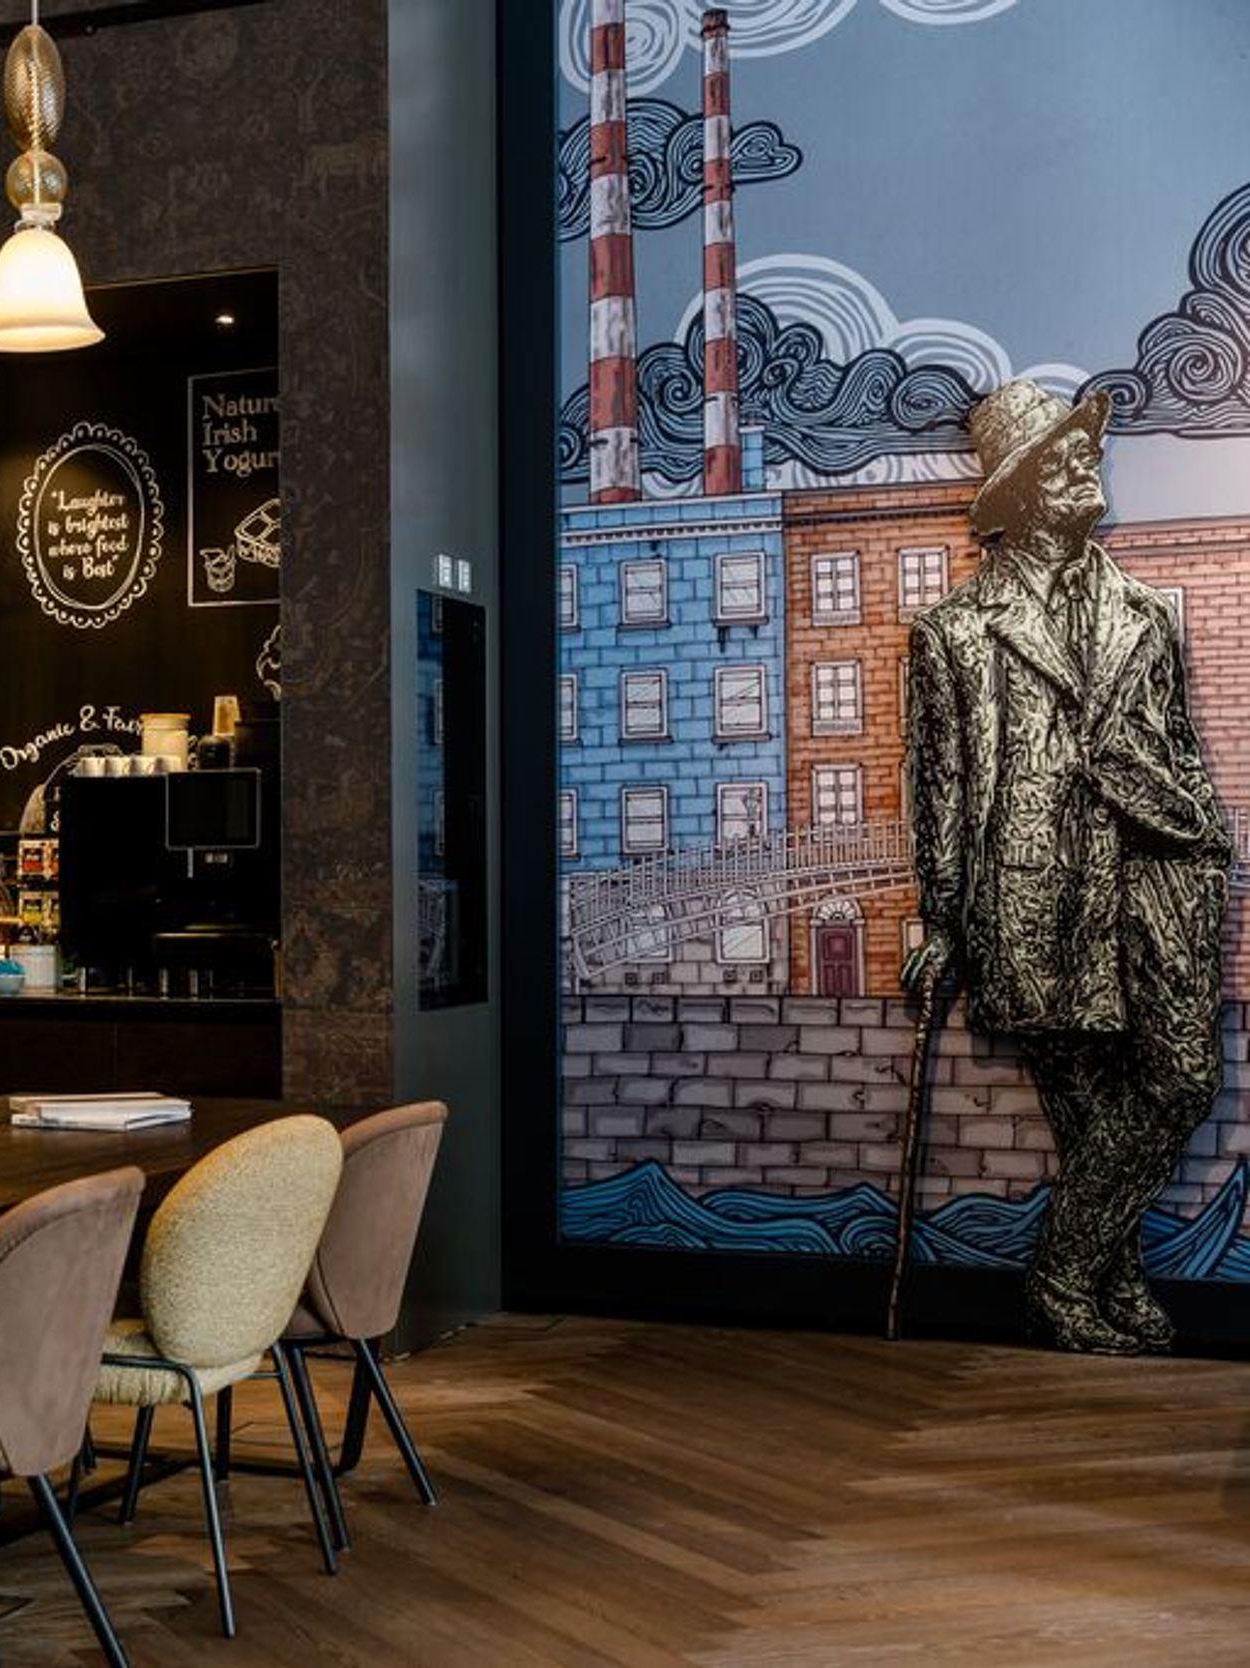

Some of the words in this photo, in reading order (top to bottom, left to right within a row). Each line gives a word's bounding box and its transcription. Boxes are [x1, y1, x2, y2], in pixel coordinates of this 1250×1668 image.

[202, 393, 278, 419] Natur
[202, 418, 258, 447] Irish
[202, 448, 279, 478] Yogur
[0, 722, 76, 770] Organic
[79, 704, 101, 732] &
[102, 705, 142, 737] Fair
